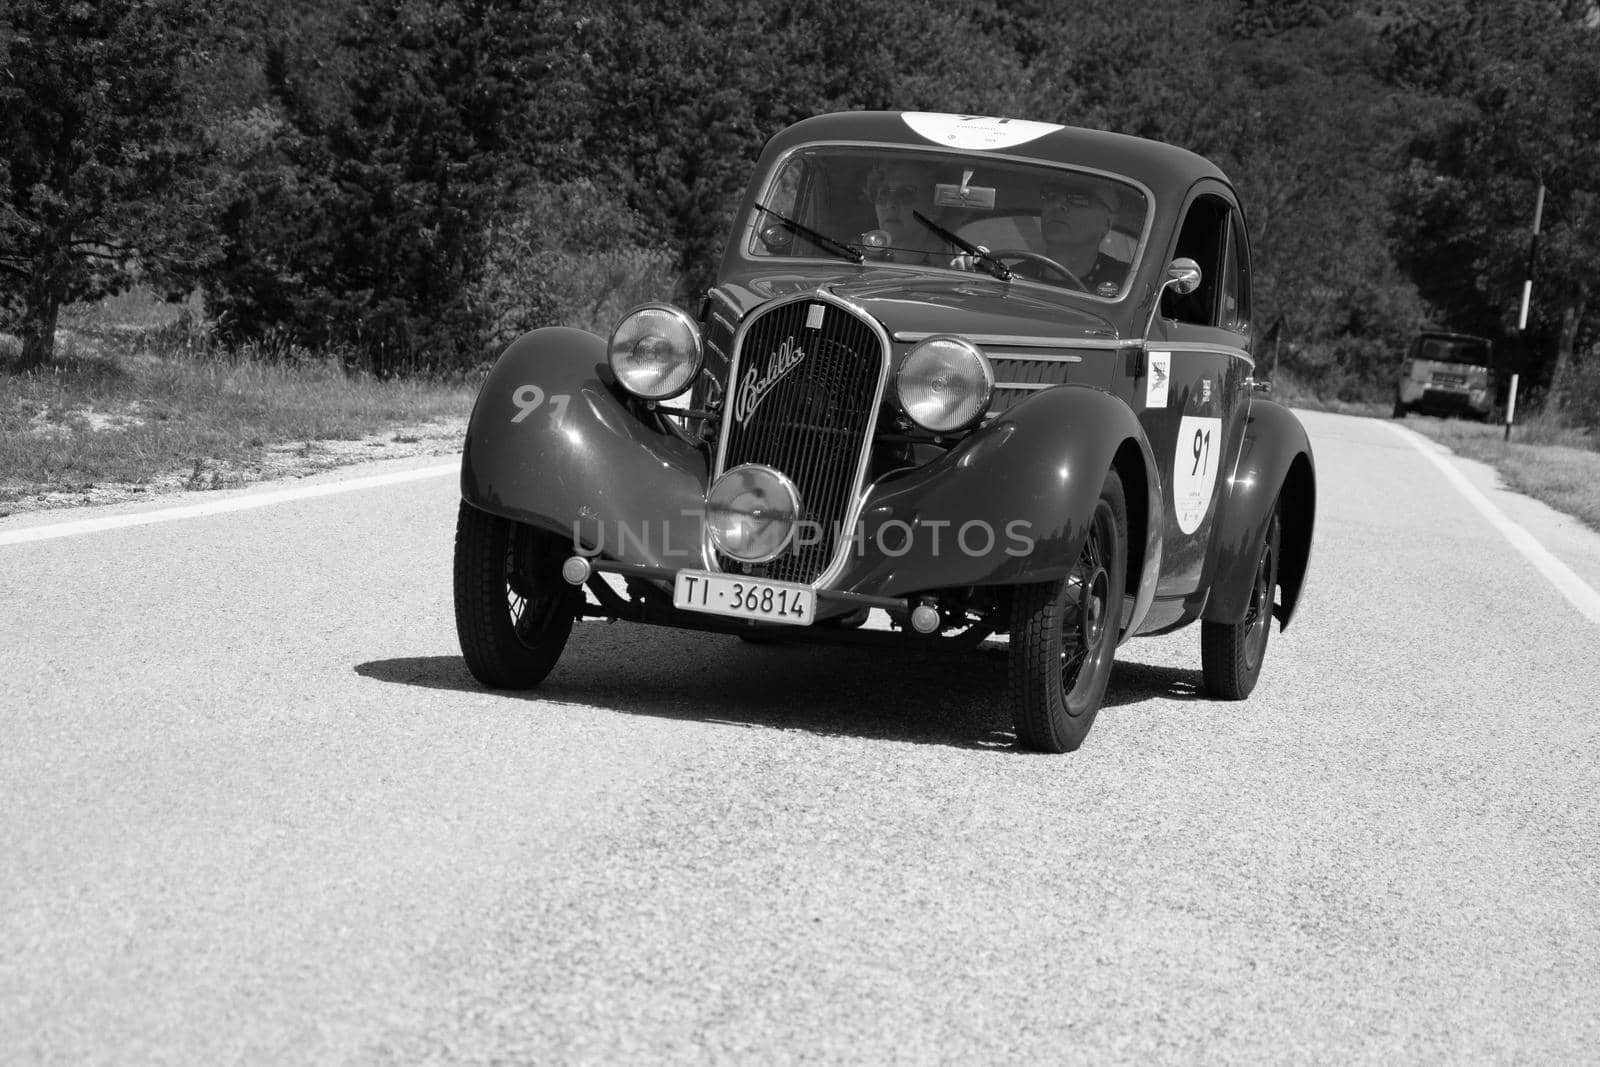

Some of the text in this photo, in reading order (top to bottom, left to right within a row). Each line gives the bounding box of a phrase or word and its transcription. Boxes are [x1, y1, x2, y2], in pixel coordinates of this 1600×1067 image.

[735, 335, 805, 430] Balilla
[510, 384, 571, 432] 91
[1191, 428, 1211, 477] 91
[729, 583, 804, 618] 36814
